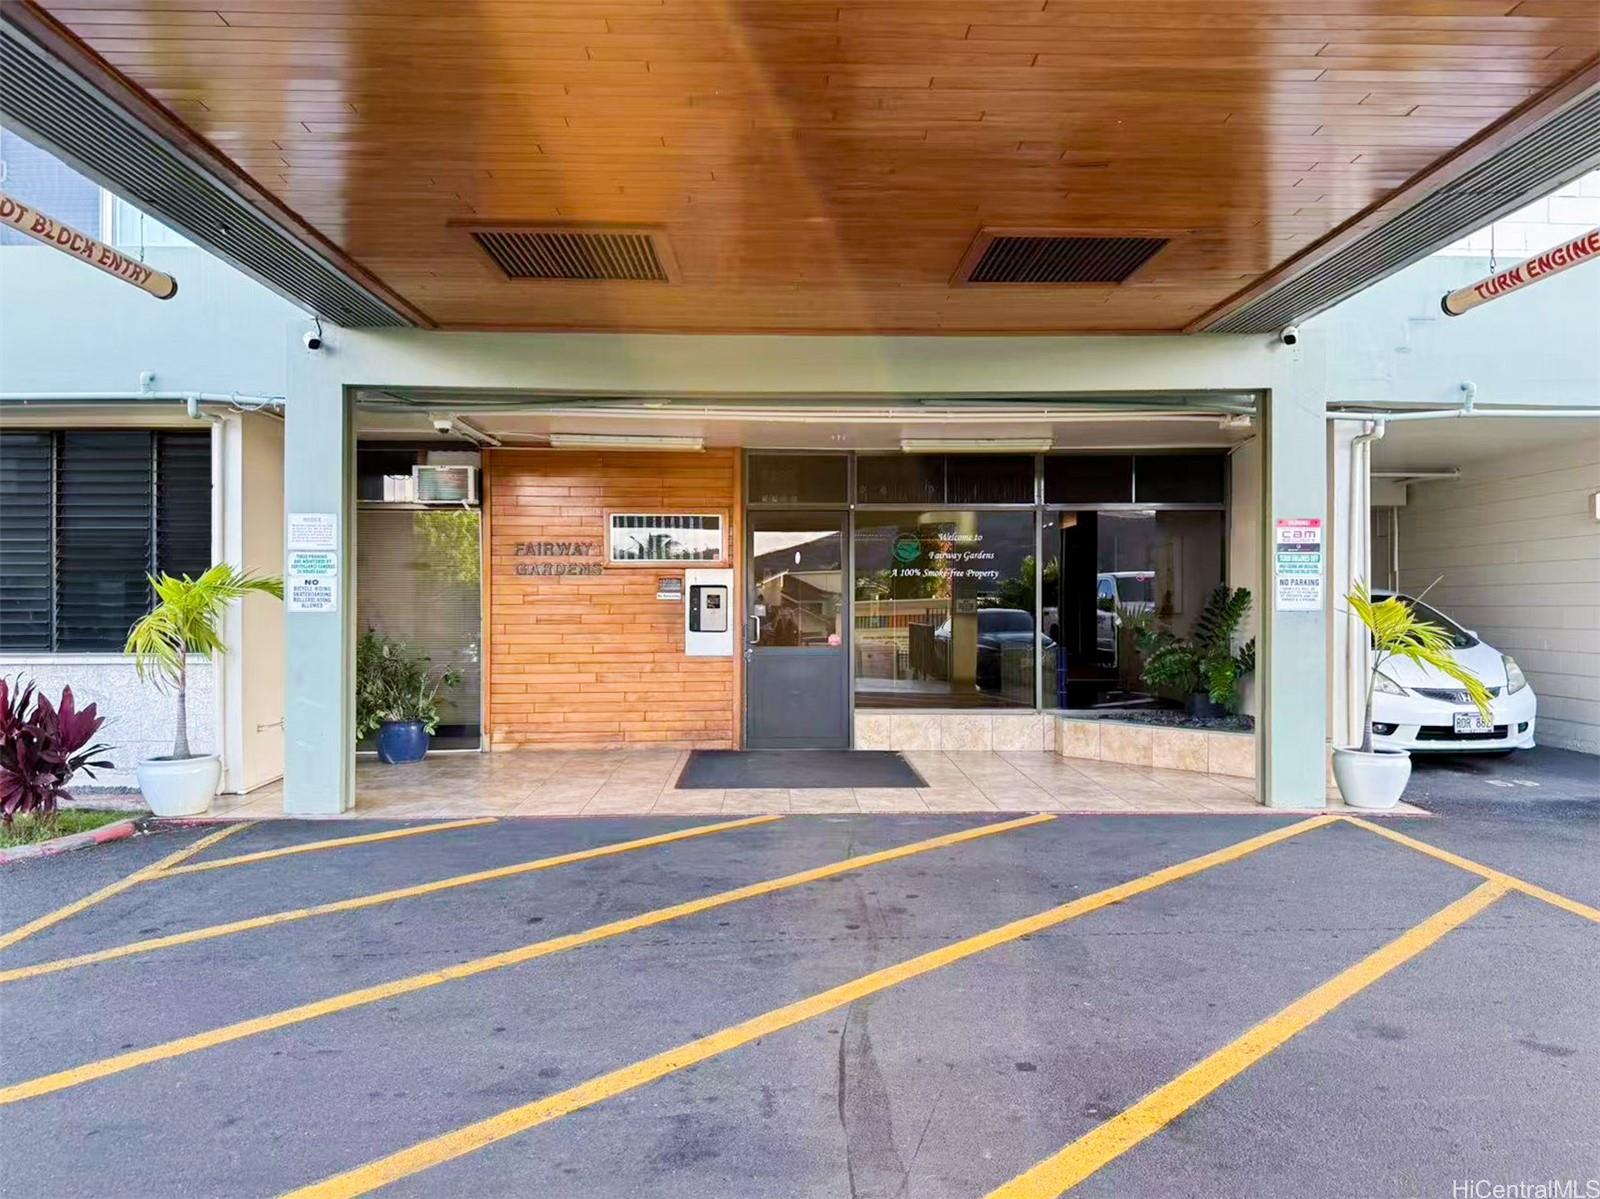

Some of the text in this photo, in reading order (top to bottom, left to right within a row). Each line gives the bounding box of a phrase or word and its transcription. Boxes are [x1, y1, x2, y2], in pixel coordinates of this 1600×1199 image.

[30, 212, 96, 260] BLOCK
[97, 249, 153, 285] ENTRY
[1474, 231, 1600, 300] TURN ENGINE
[938, 531, 984, 542] Welcome to
[515, 540, 595, 557] FAIRWAY
[928, 550, 995, 563] Fairway Gardens
[515, 561, 604, 577] GARDENS
[889, 568, 898, 578] A
[900, 568, 921, 577] 100%
[965, 568, 1000, 580] Property
[1291, 579, 1320, 587] PARKING
